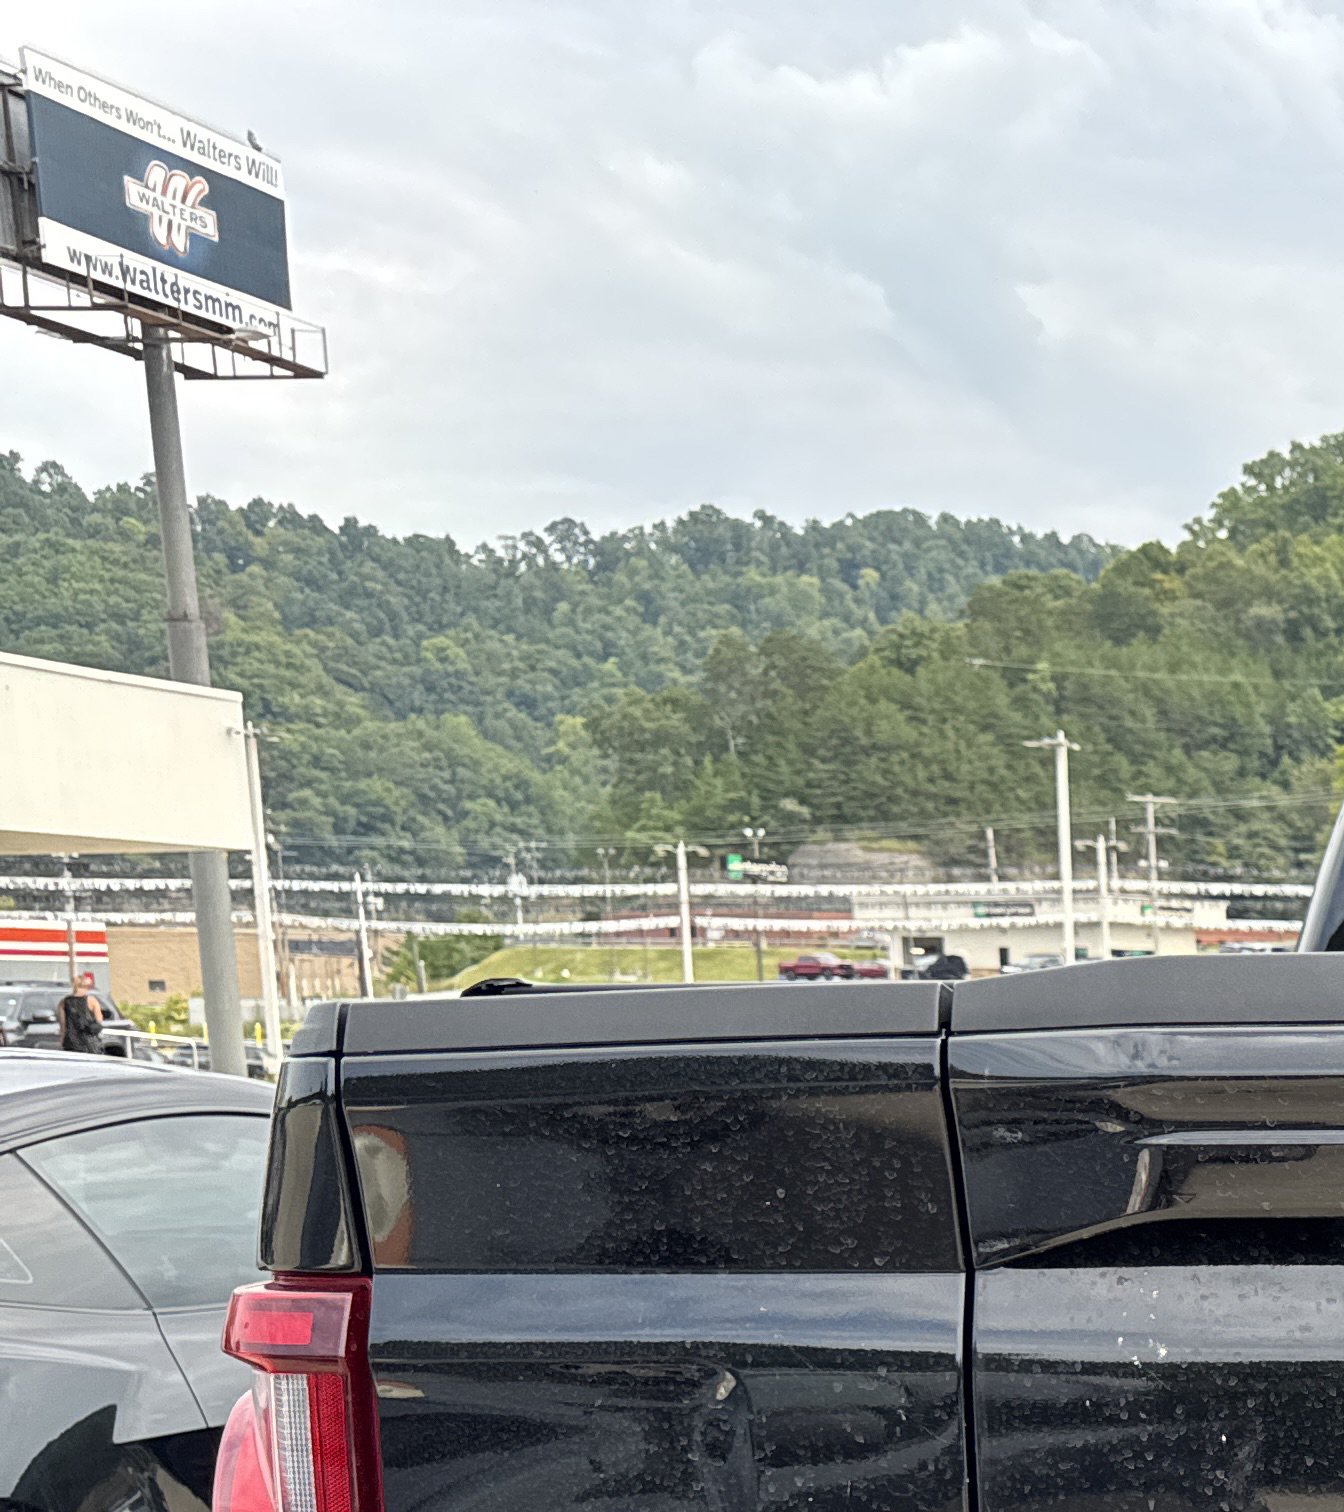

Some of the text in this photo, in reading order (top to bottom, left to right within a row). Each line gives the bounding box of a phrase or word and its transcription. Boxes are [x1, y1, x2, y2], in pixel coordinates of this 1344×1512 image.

[33, 65, 279, 188] When Others Won't... Walters Will!
[138, 189, 208, 229] WALTERS
